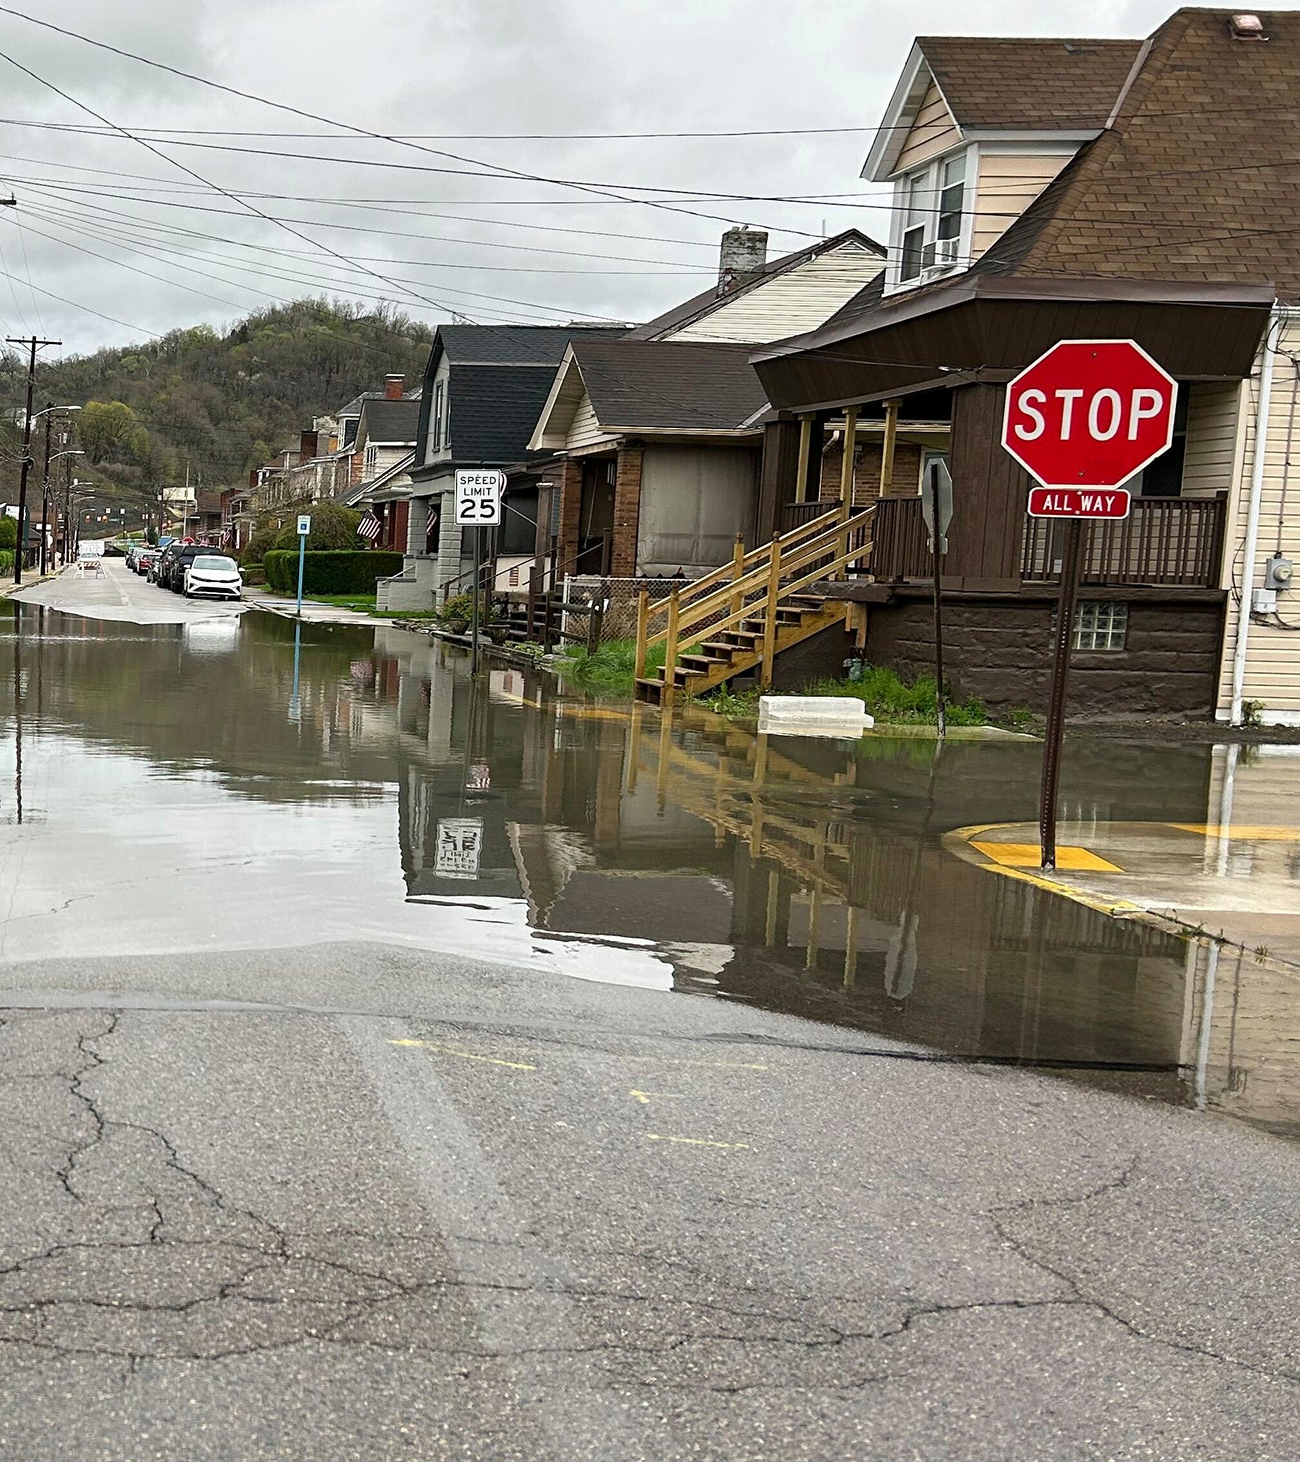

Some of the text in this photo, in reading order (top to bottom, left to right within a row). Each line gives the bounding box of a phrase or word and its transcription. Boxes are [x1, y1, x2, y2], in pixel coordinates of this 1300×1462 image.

[1014, 388, 1163, 441] STOP
[460, 476, 496, 485] SPEED
[464, 487, 492, 496] LIMIT
[460, 499, 495, 518] 25
[1043, 495, 1116, 512] ALL WAY
